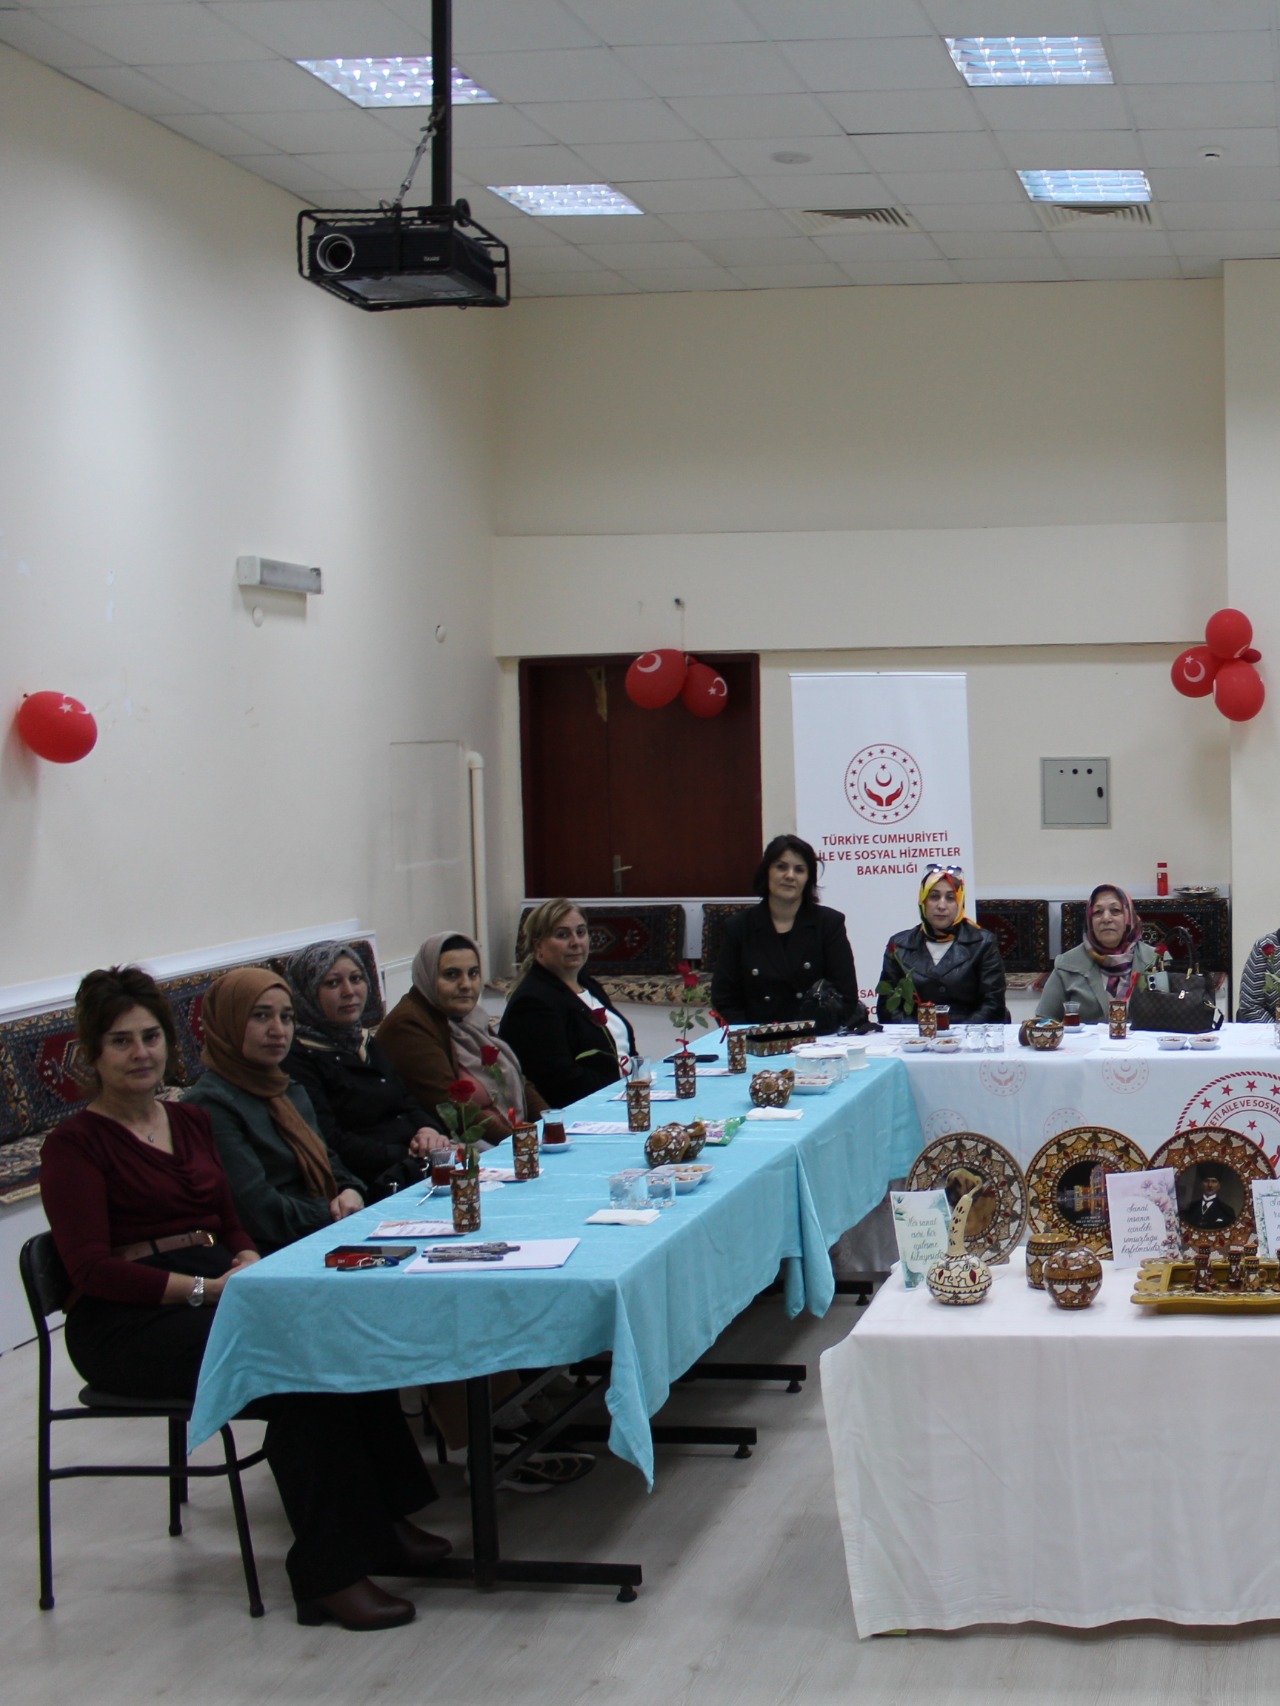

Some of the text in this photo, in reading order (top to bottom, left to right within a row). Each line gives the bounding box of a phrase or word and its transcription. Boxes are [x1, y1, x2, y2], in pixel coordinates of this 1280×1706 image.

[822, 830, 948, 846] TÜRKİYE CUMHURİYETİ
[818, 846, 961, 862] İLE VE SOSYAL HİZMETLER
[857, 863, 918, 876] BAKANLIĞI
[1221, 1102, 1239, 1116] AİLE
[1240, 1100, 1251, 1108] VE
